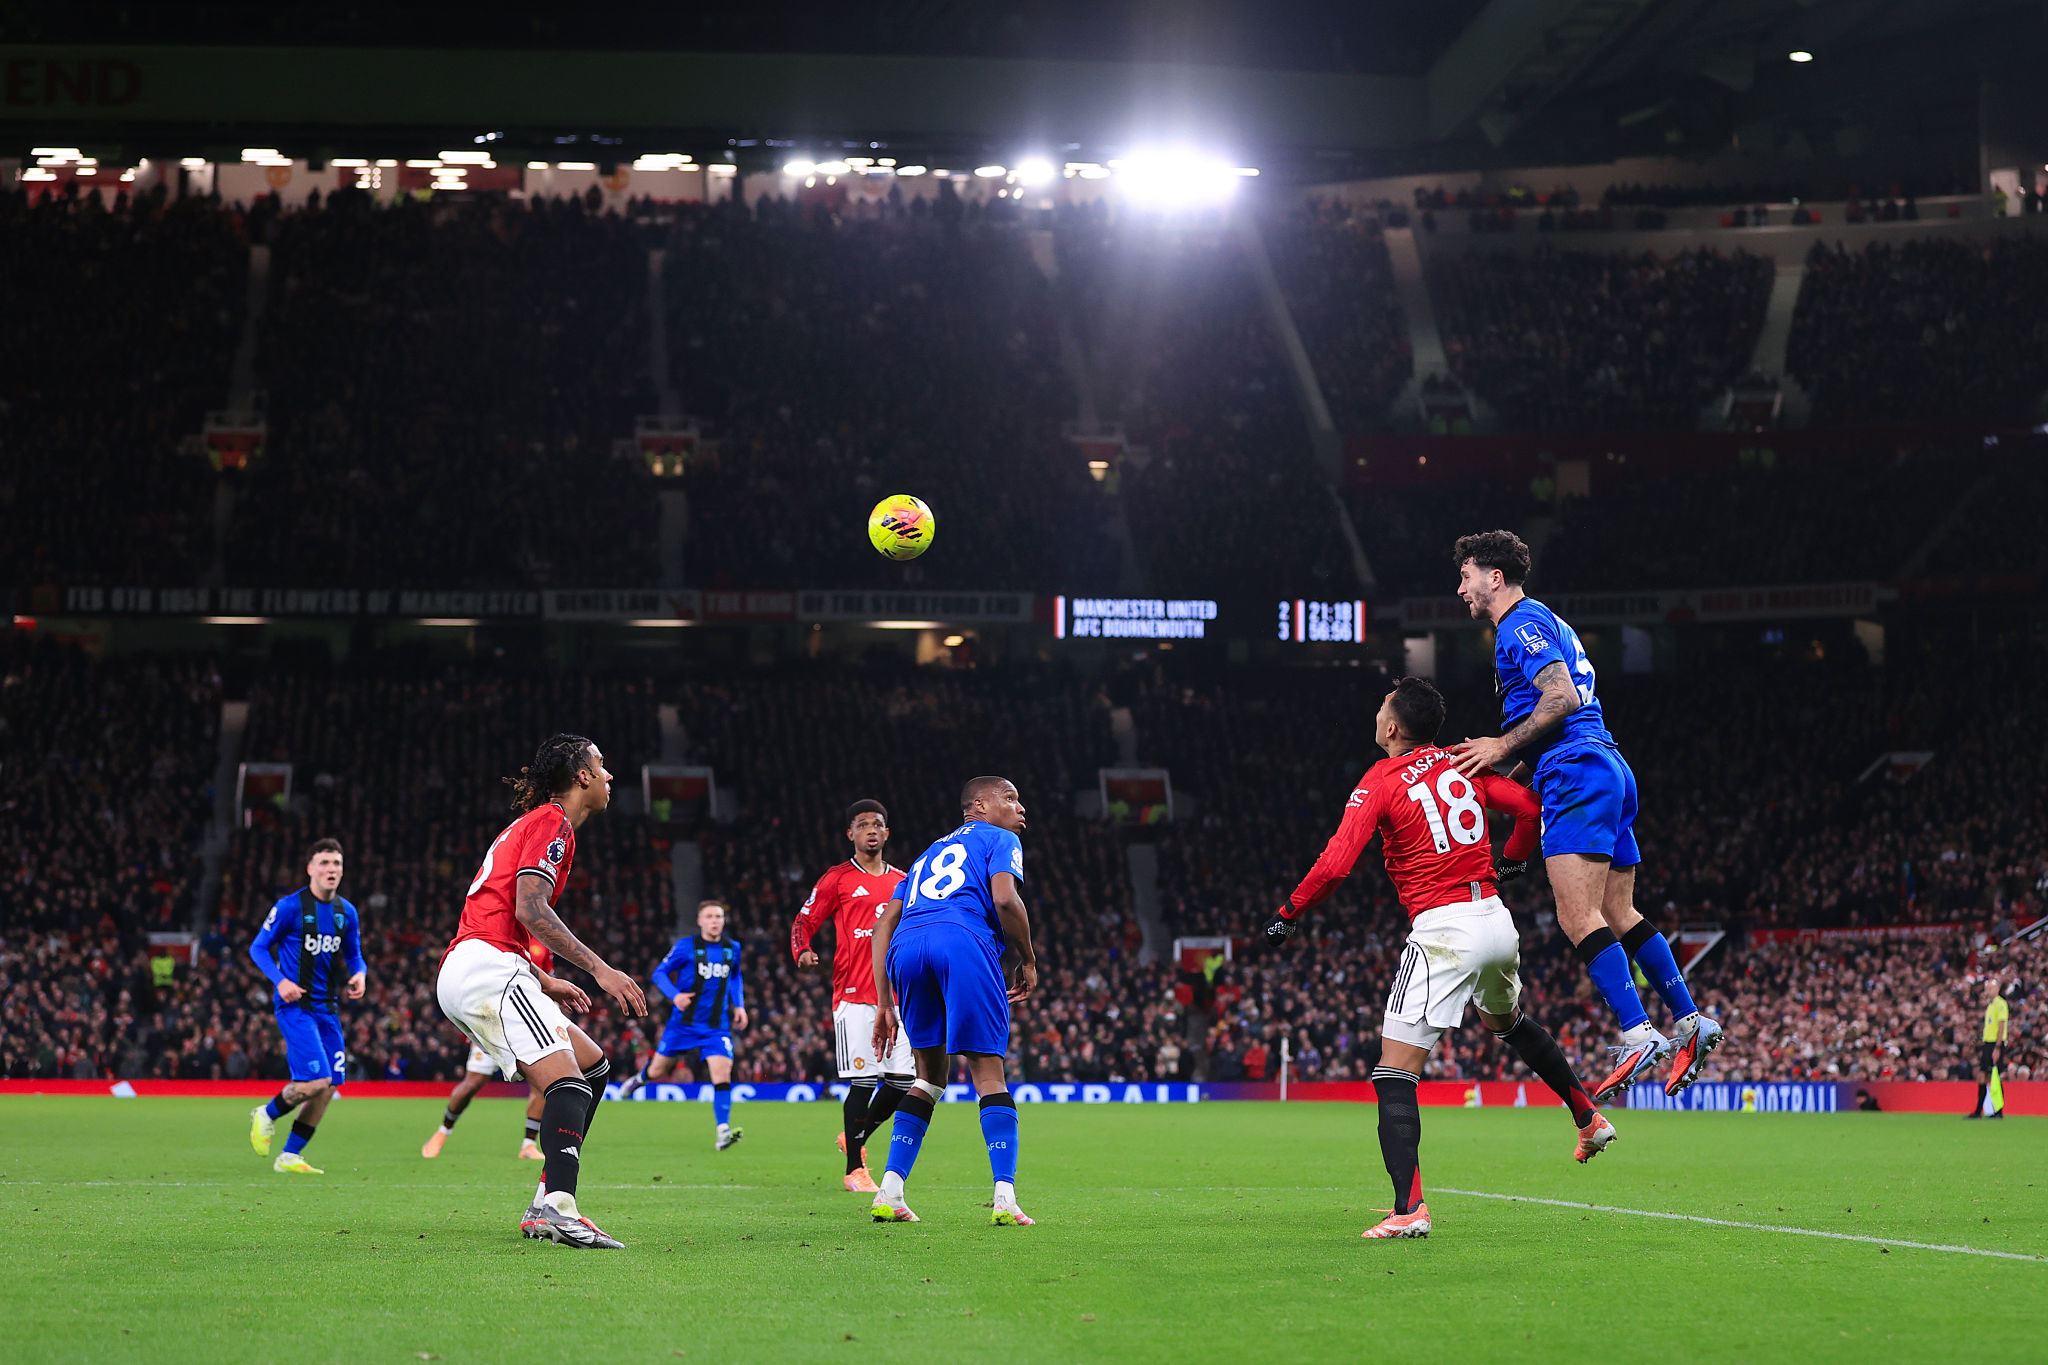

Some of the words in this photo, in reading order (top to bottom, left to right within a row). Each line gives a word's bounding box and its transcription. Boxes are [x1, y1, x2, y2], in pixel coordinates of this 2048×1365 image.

[7, 60, 142, 105] END
[219, 588, 256, 613] THE
[262, 588, 360, 613] FLOWERS
[400, 590, 537, 614] MANCHESTER
[1073, 599, 1165, 618] MANCHESTER
[1167, 600, 1217, 619] UNITED
[1279, 601, 1290, 620] 2
[1073, 618, 1101, 637] AFC
[1102, 619, 1204, 638] BOURNEMOUTH
[1278, 621, 1290, 640] 3
[1407, 768, 1486, 855] 18
[906, 843, 968, 909] 18
[304, 933, 342, 956] bj88
[698, 962, 731, 980] bj88
[891, 1134, 914, 1146] AFCB
